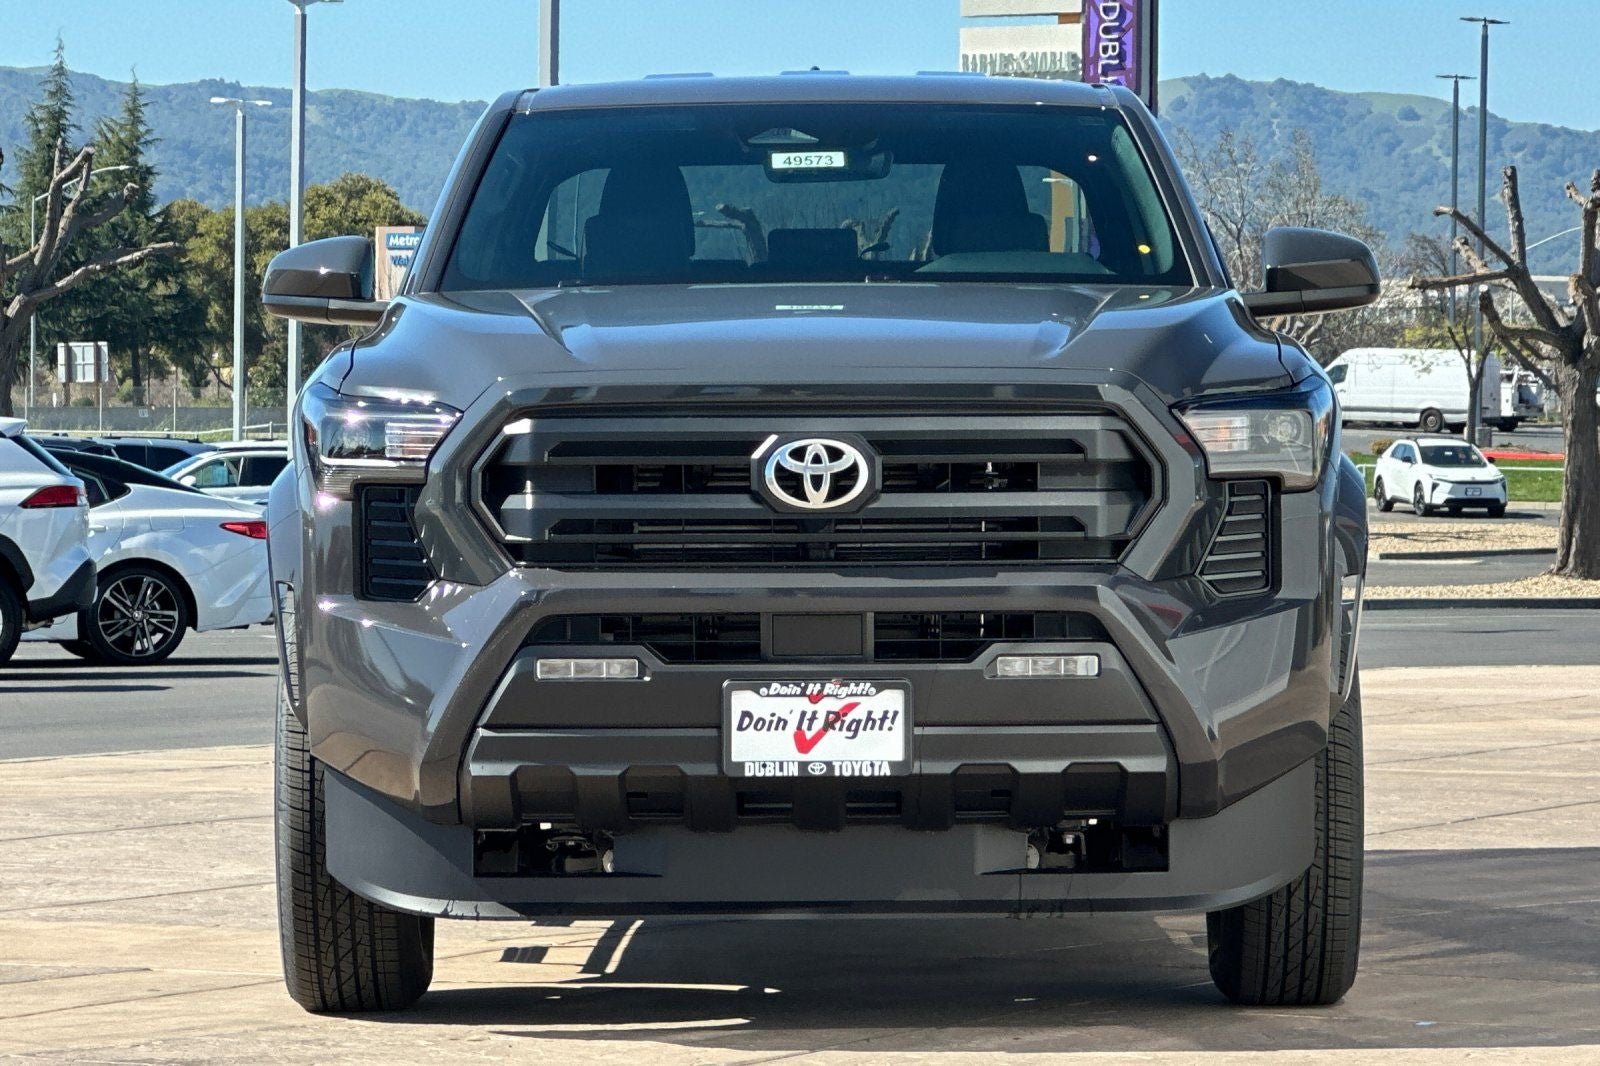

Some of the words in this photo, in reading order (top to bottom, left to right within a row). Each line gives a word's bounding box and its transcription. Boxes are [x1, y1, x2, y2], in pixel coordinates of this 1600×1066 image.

[783, 155, 834, 166] 49573
[768, 682, 804, 696] Doin'
[806, 682, 823, 696] It
[823, 682, 871, 699] Right!
[736, 709, 794, 732] Doin'
[796, 710, 819, 732] It
[823, 710, 899, 740] Right!
[744, 761, 799, 776] DUBLIN
[832, 761, 891, 776] TOYOTA
